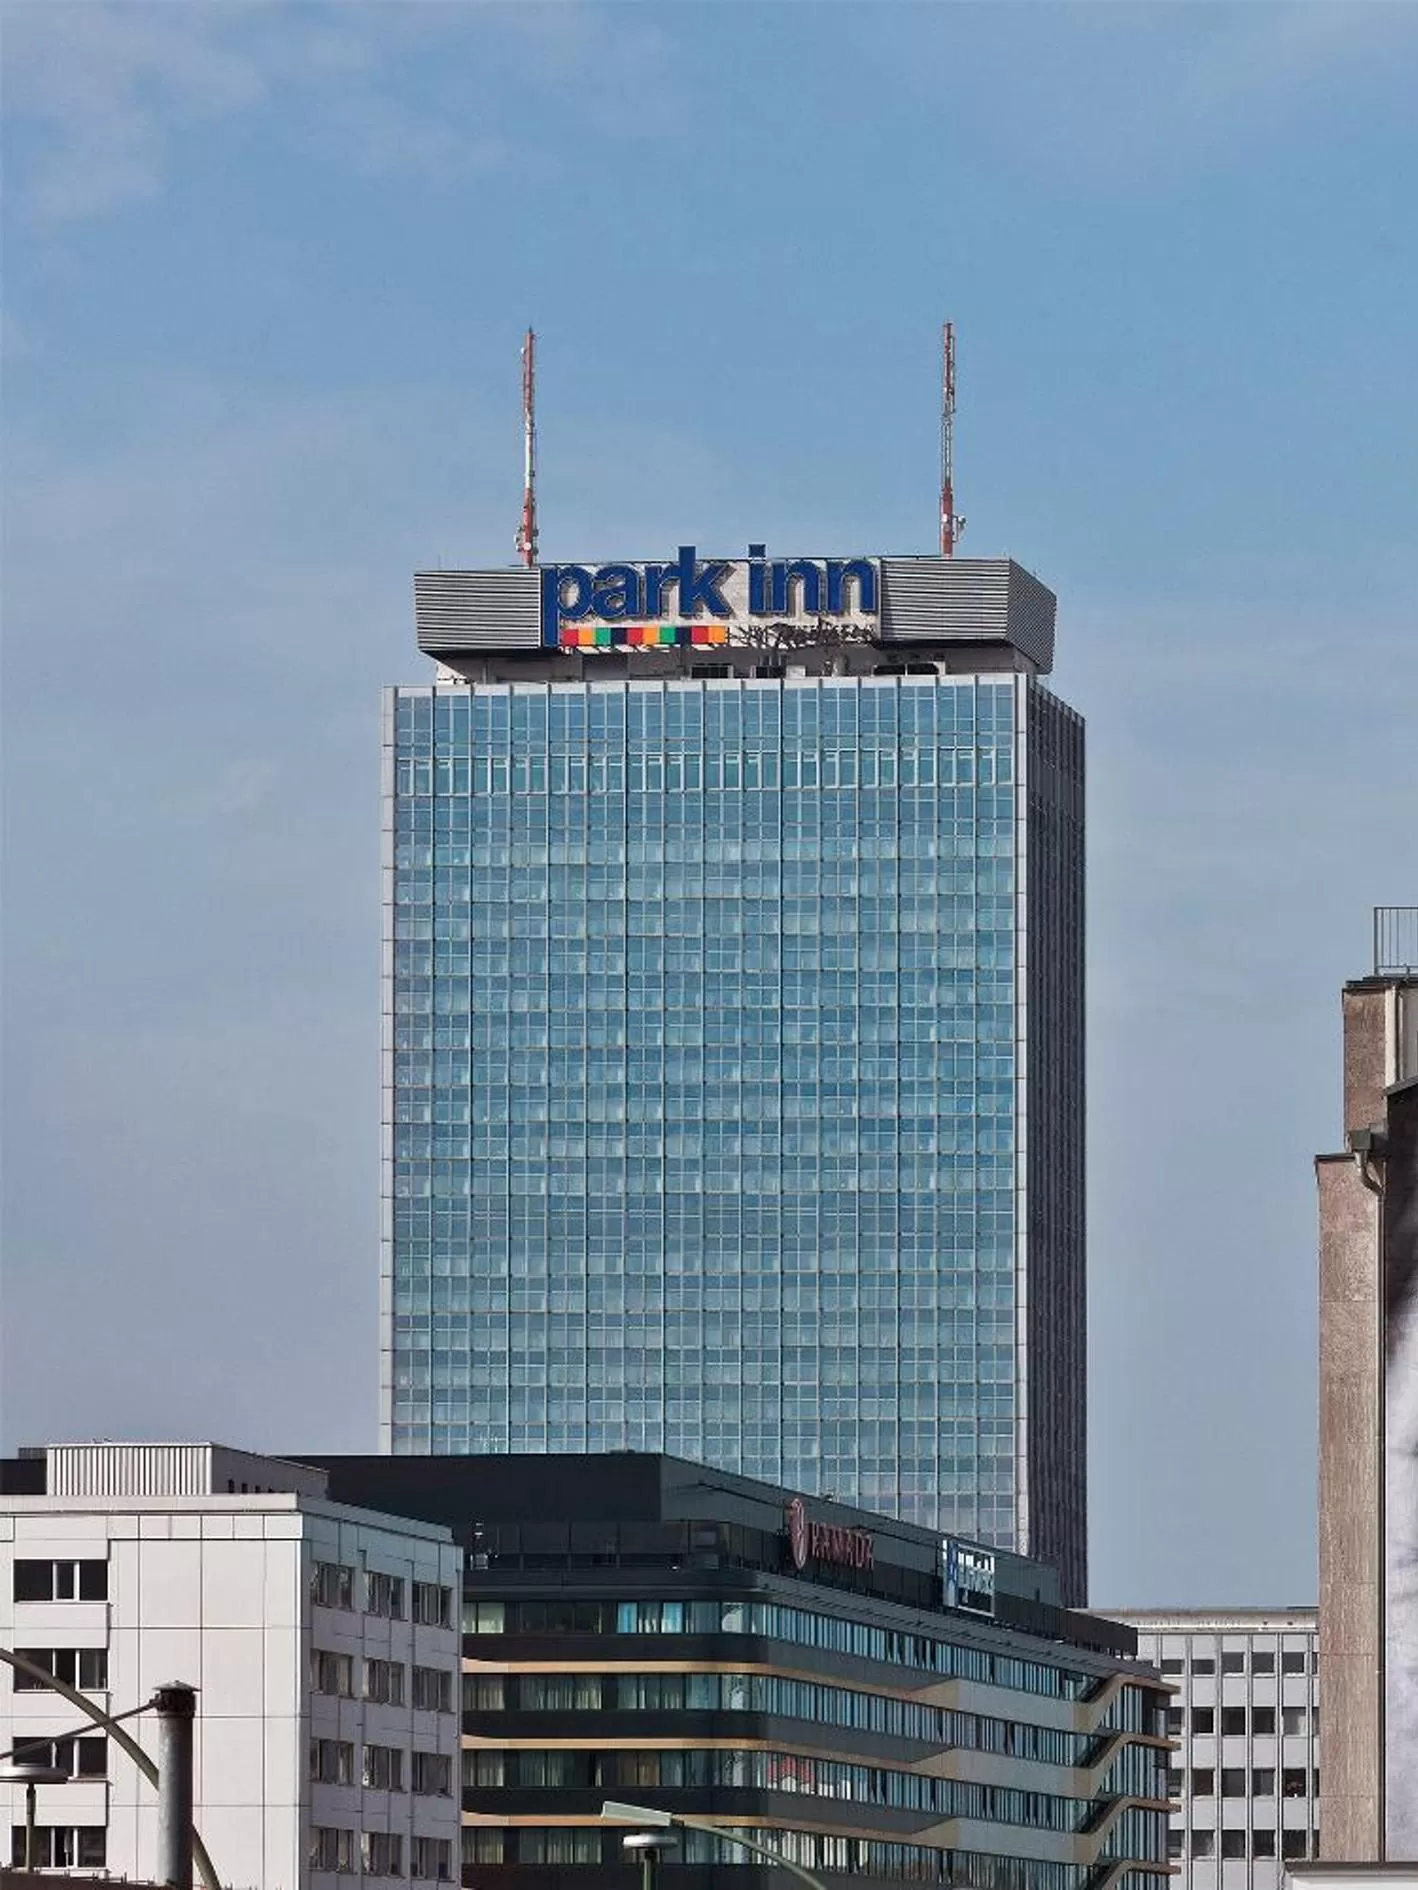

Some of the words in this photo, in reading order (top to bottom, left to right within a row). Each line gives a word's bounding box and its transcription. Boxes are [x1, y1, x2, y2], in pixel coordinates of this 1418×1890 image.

[542, 545, 734, 648] park
[747, 543, 879, 614] inn
[811, 1520, 875, 1570] RAMADA
